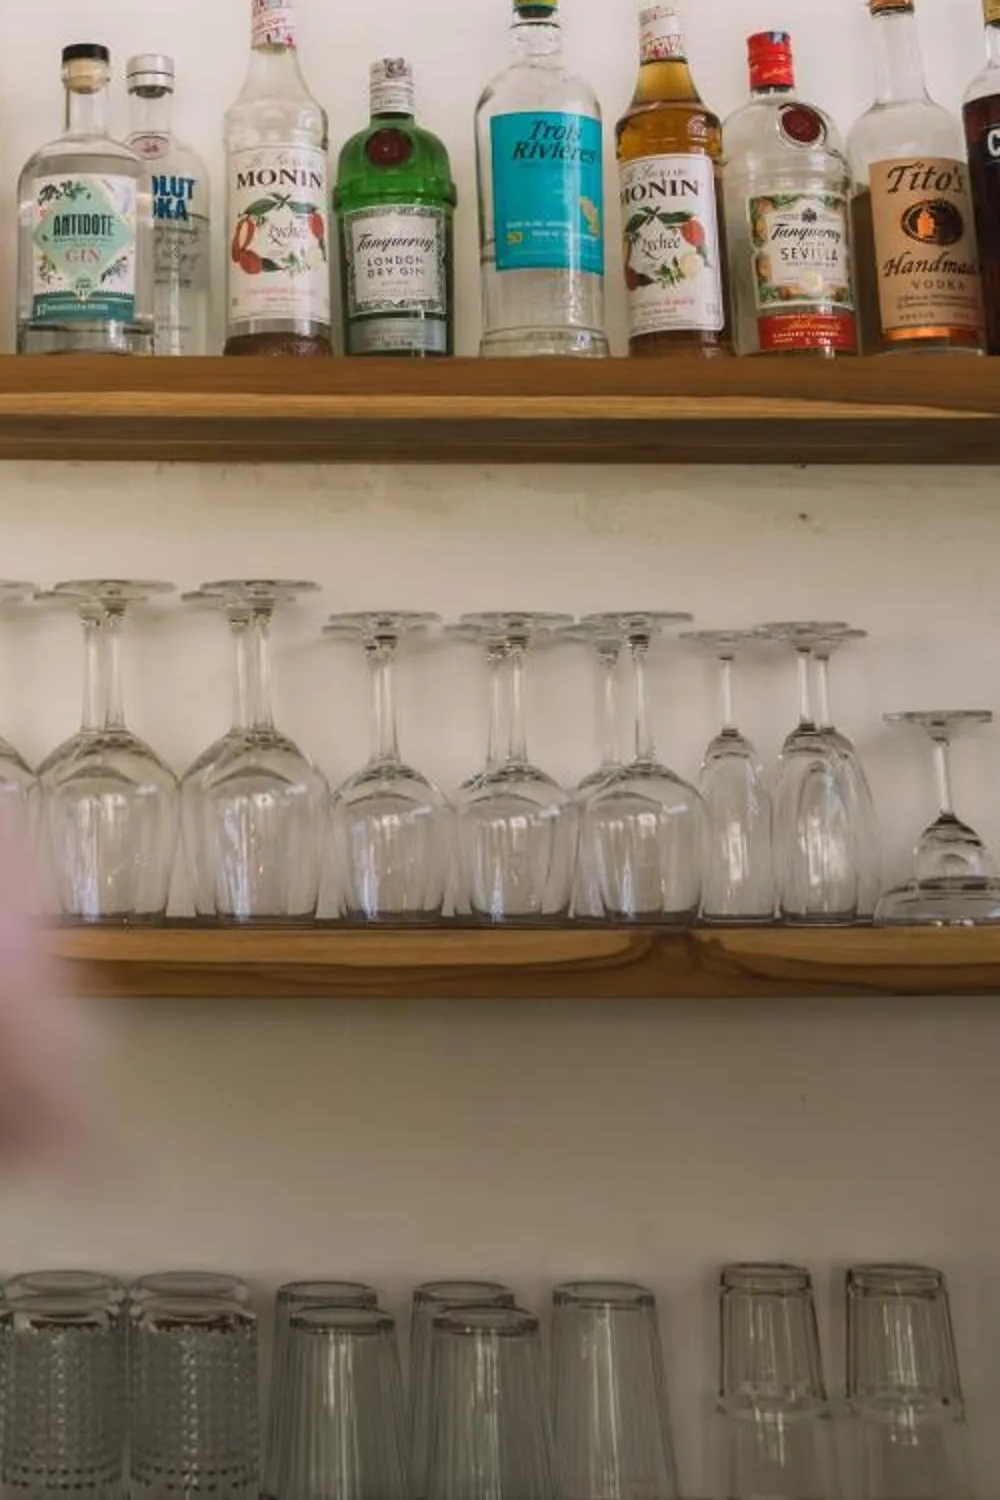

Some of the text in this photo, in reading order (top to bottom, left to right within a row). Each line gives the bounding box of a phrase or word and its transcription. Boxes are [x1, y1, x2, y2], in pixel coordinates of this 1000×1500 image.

[237, 168, 323, 190] MONIN
[887, 161, 966, 194] Tito's
[53, 213, 115, 237] ANTIDOTE
[367, 255, 424, 267] LONDON
[367, 266, 424, 278] DRY GIN
[883, 251, 984, 278] Handma
[911, 279, 966, 291] VODKA
